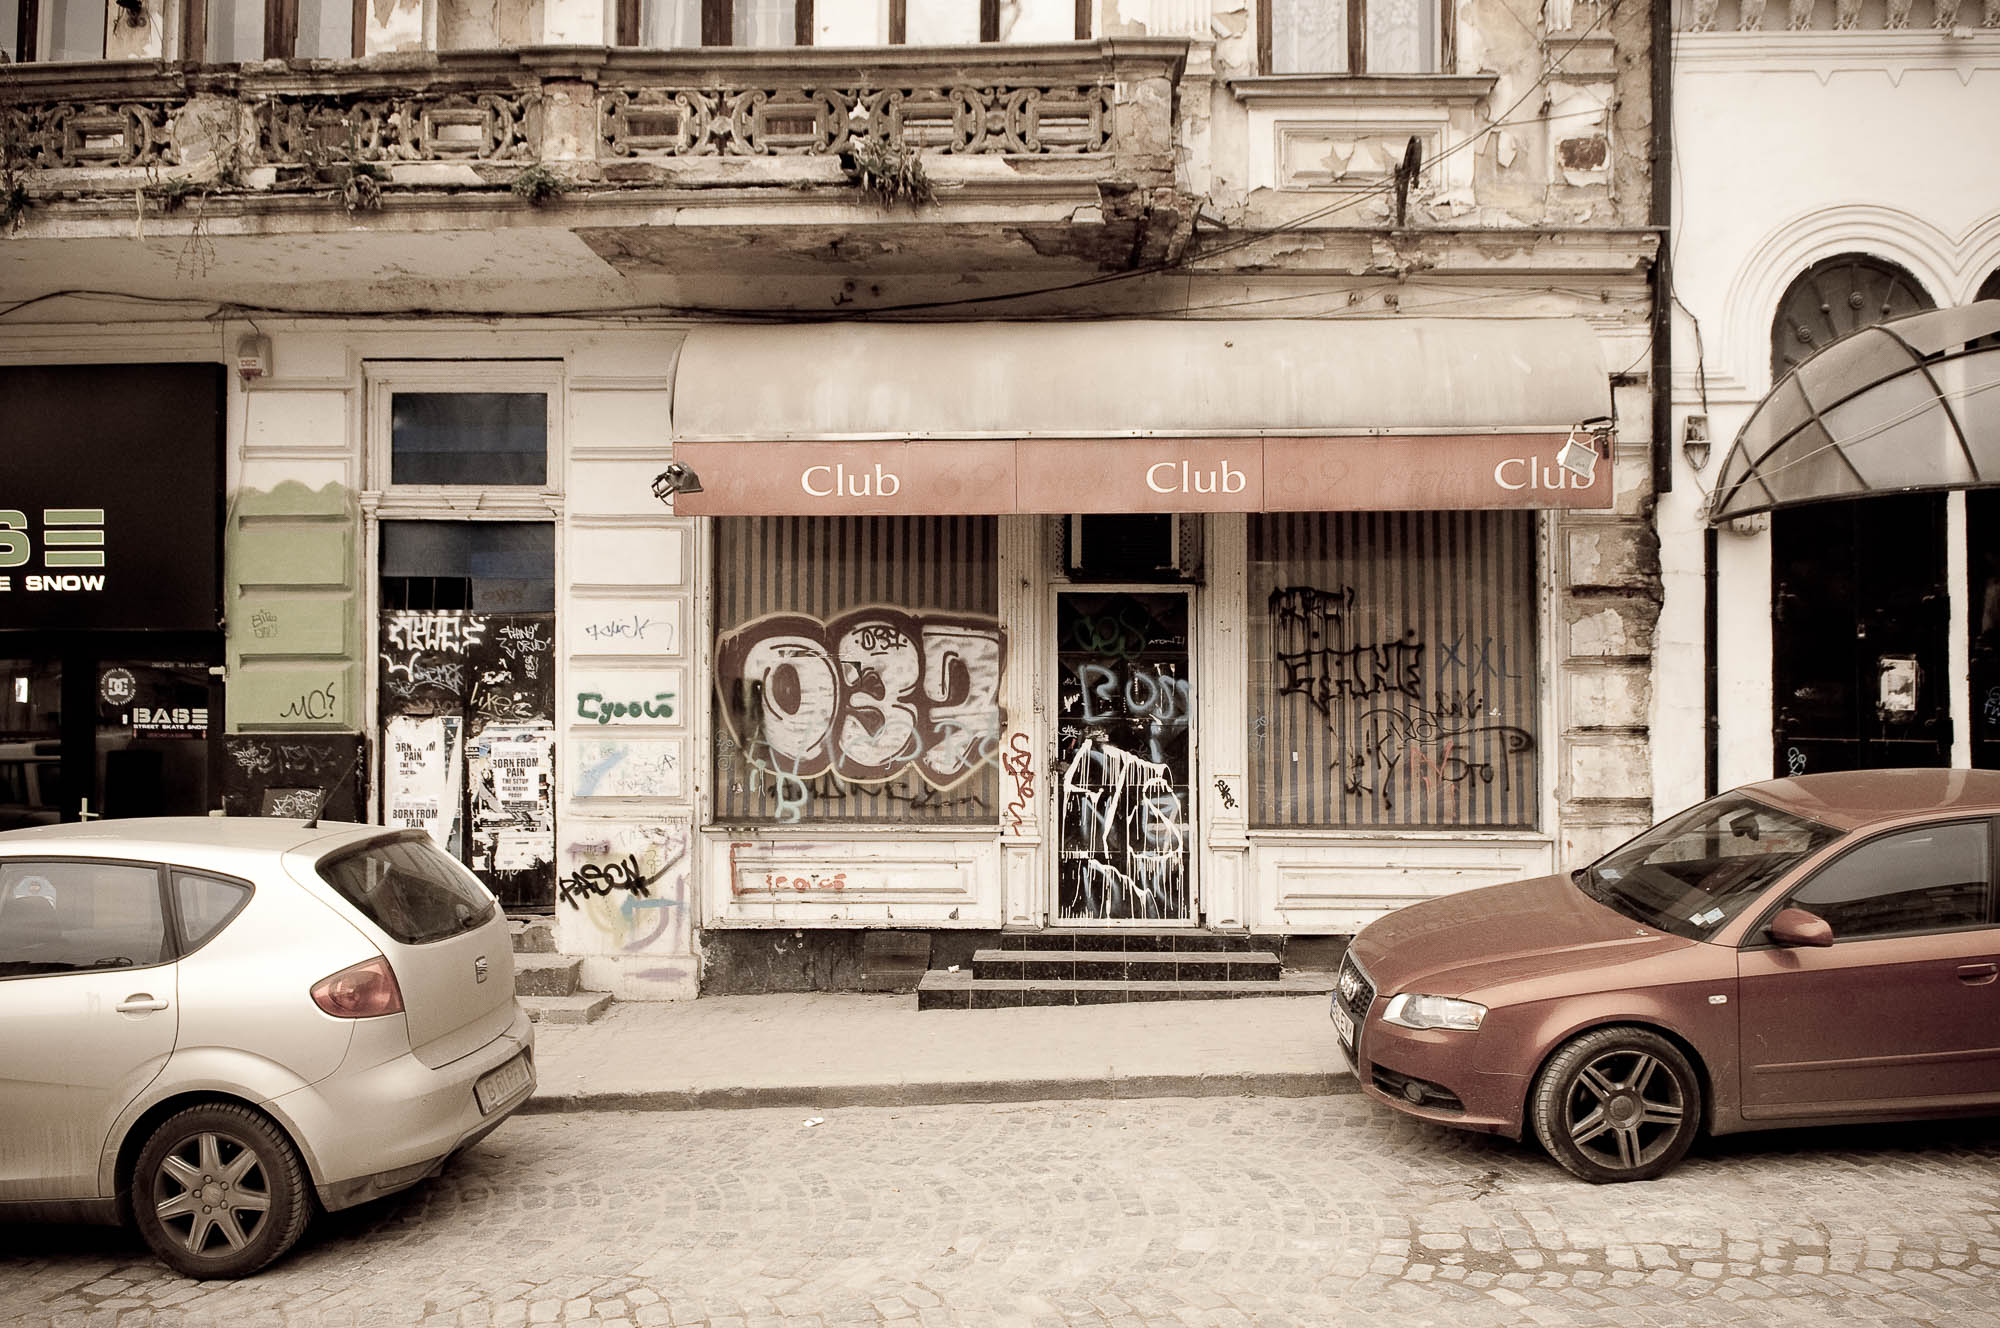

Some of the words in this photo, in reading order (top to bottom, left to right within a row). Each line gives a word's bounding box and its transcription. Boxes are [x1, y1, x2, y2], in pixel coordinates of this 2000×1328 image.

[801, 464, 900, 497] Club
[1145, 460, 1246, 494] Club
[25, 575, 105, 591] SNOW
[133, 708, 208, 724] BASE
[404, 752, 422, 761] PAIN
[493, 757, 515, 769] BORN
[516, 757, 539, 768] FROM
[506, 768, 525, 777] PAIN
[392, 809, 414, 819] BORN
[416, 809, 438, 819] FROM
[406, 819, 425, 828] PAIN
